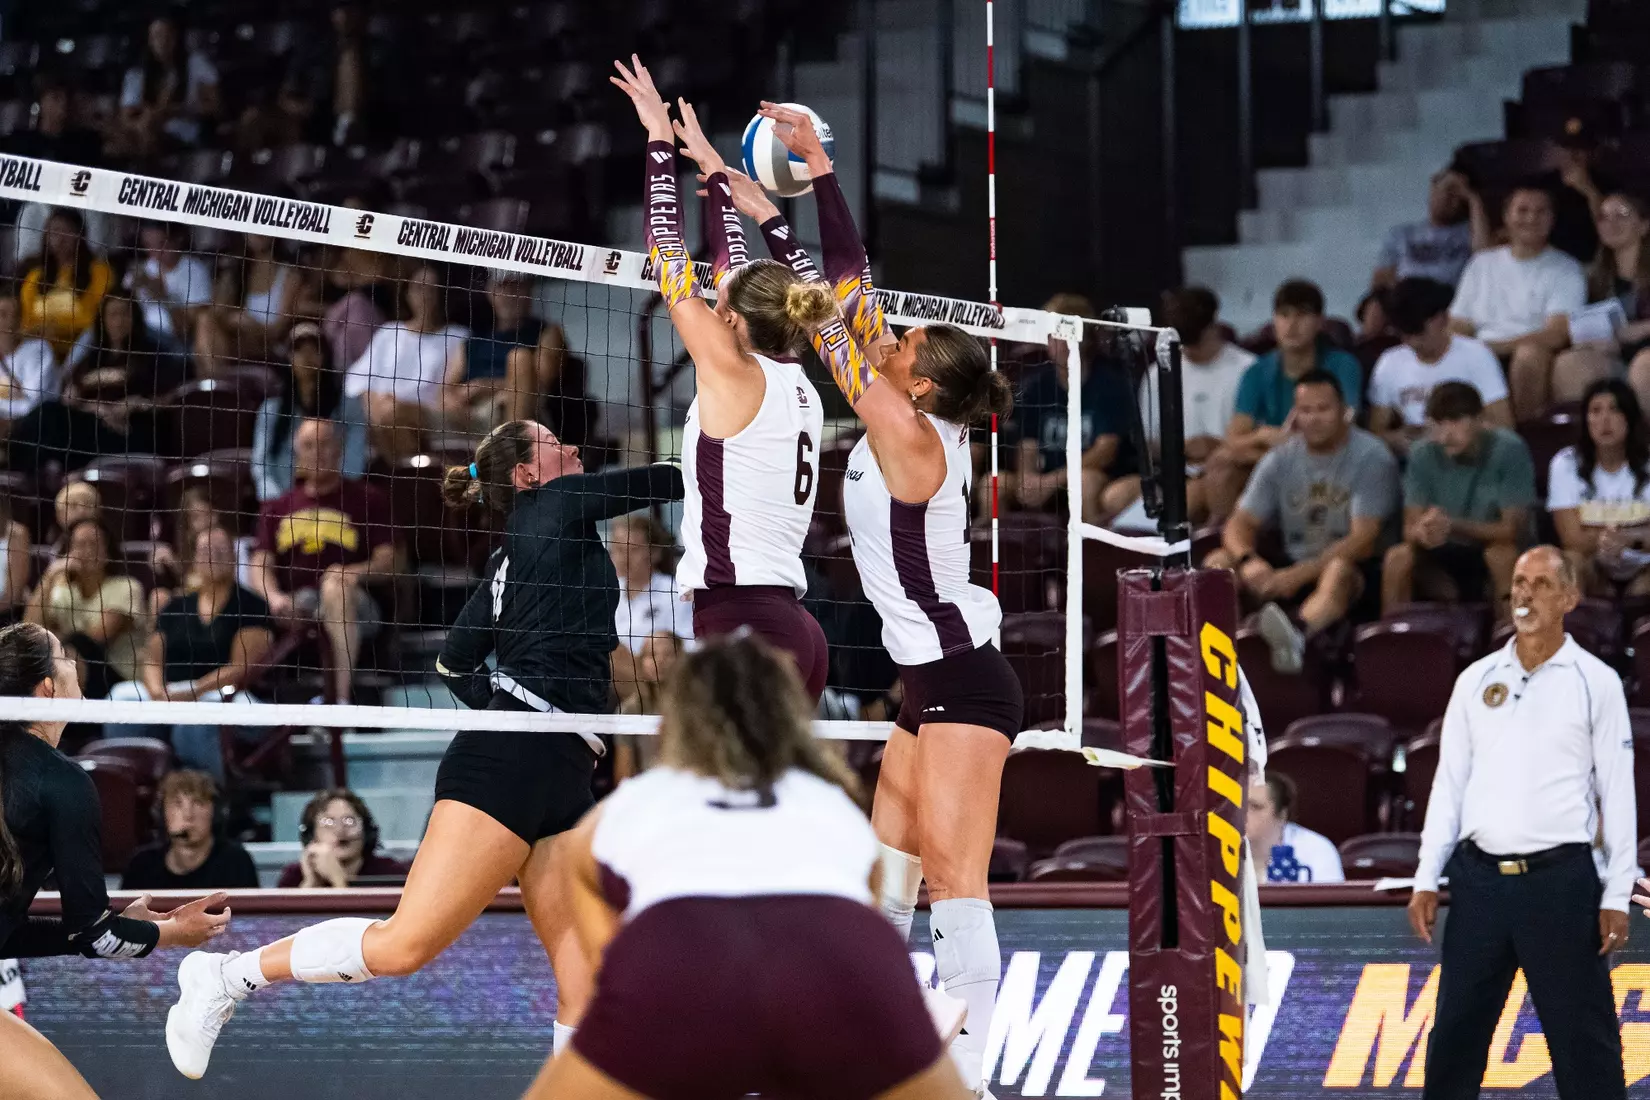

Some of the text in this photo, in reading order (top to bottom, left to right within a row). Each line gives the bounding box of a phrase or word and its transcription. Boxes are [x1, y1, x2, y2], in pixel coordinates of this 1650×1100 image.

[118, 177, 331, 234] CENTRAL MICHIGAN VOLLEYBALL
[650, 174, 687, 262] CHIPPEWAS
[397, 220, 584, 271] CENTRAL MICHIGAN VOLLEYBALL
[900, 295, 949, 322] MICHIGAN
[948, 300, 1005, 329] VOLLEYBALL
[794, 430, 813, 505] 6
[1157, 985, 1181, 1059] sports
